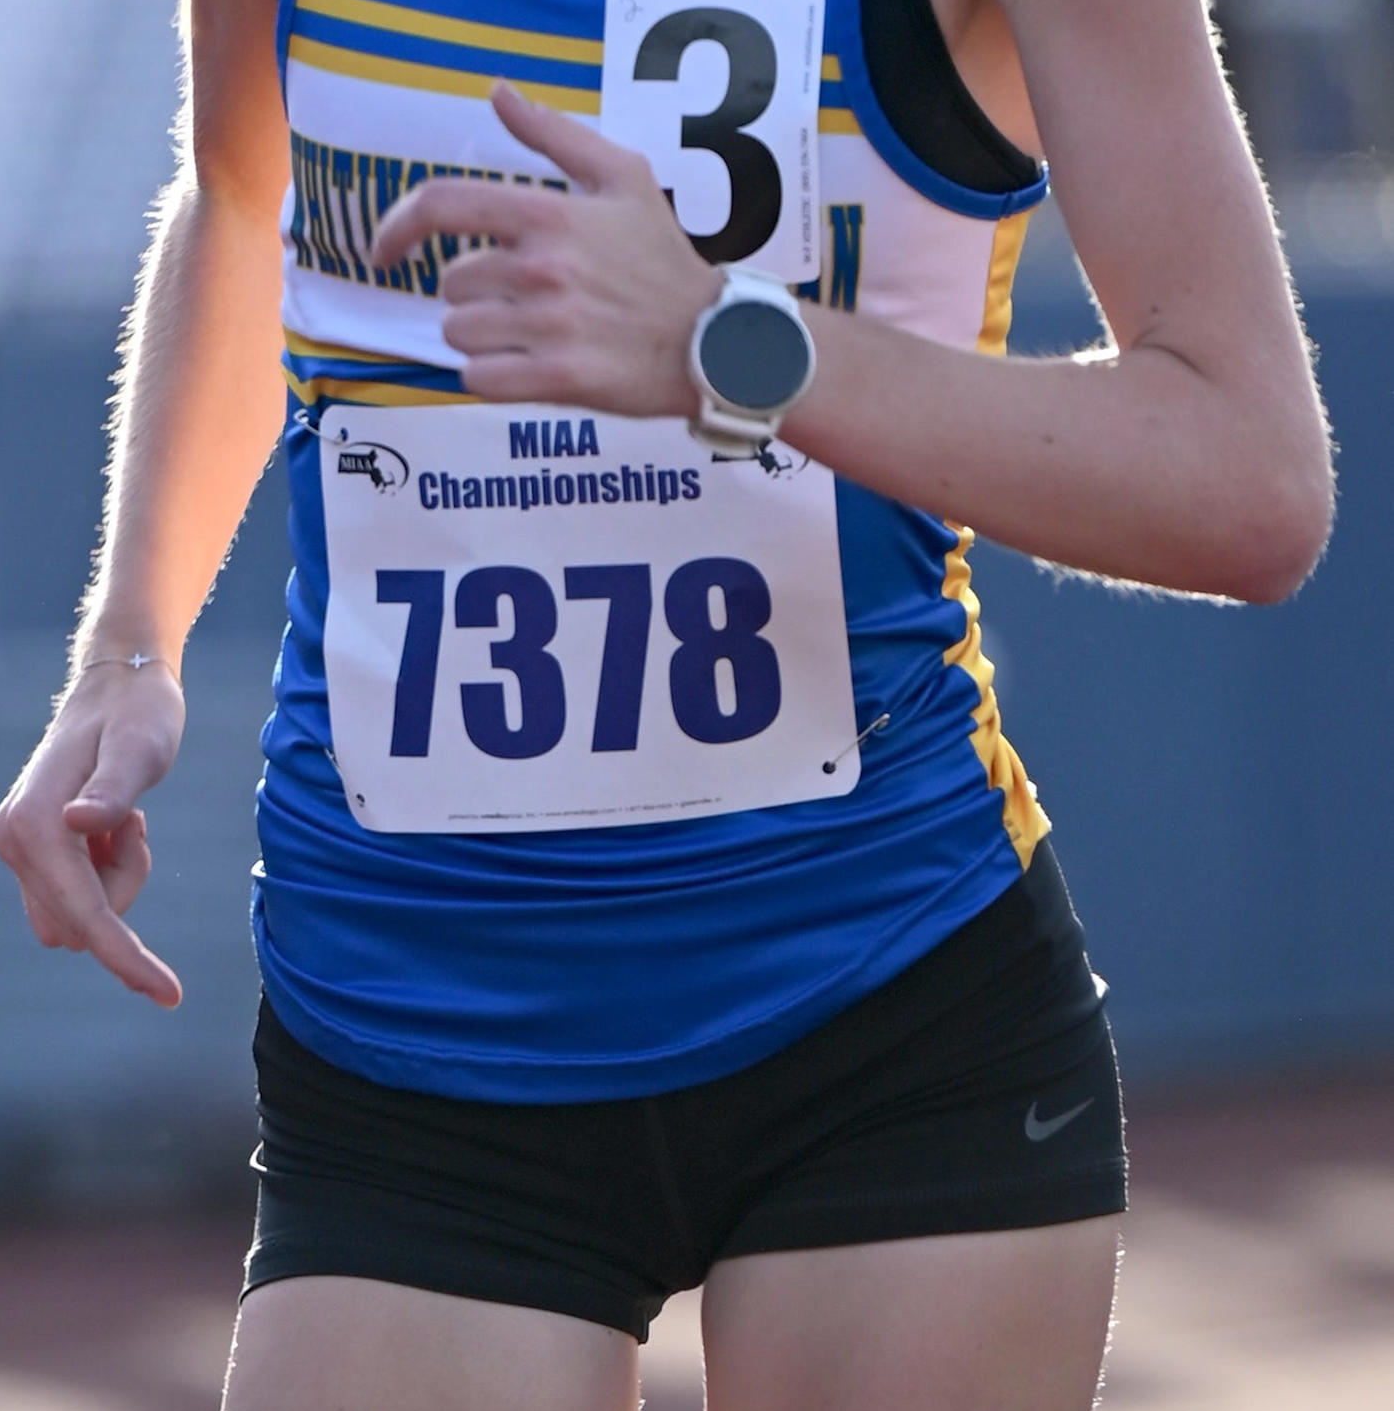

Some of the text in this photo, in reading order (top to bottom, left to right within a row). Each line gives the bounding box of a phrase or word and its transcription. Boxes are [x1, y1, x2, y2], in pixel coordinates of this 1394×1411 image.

[632, 6, 783, 265] 3
[417, 464, 702, 511] Championships
[509, 419, 600, 459] MIAA
[375, 556, 783, 760] 7378
